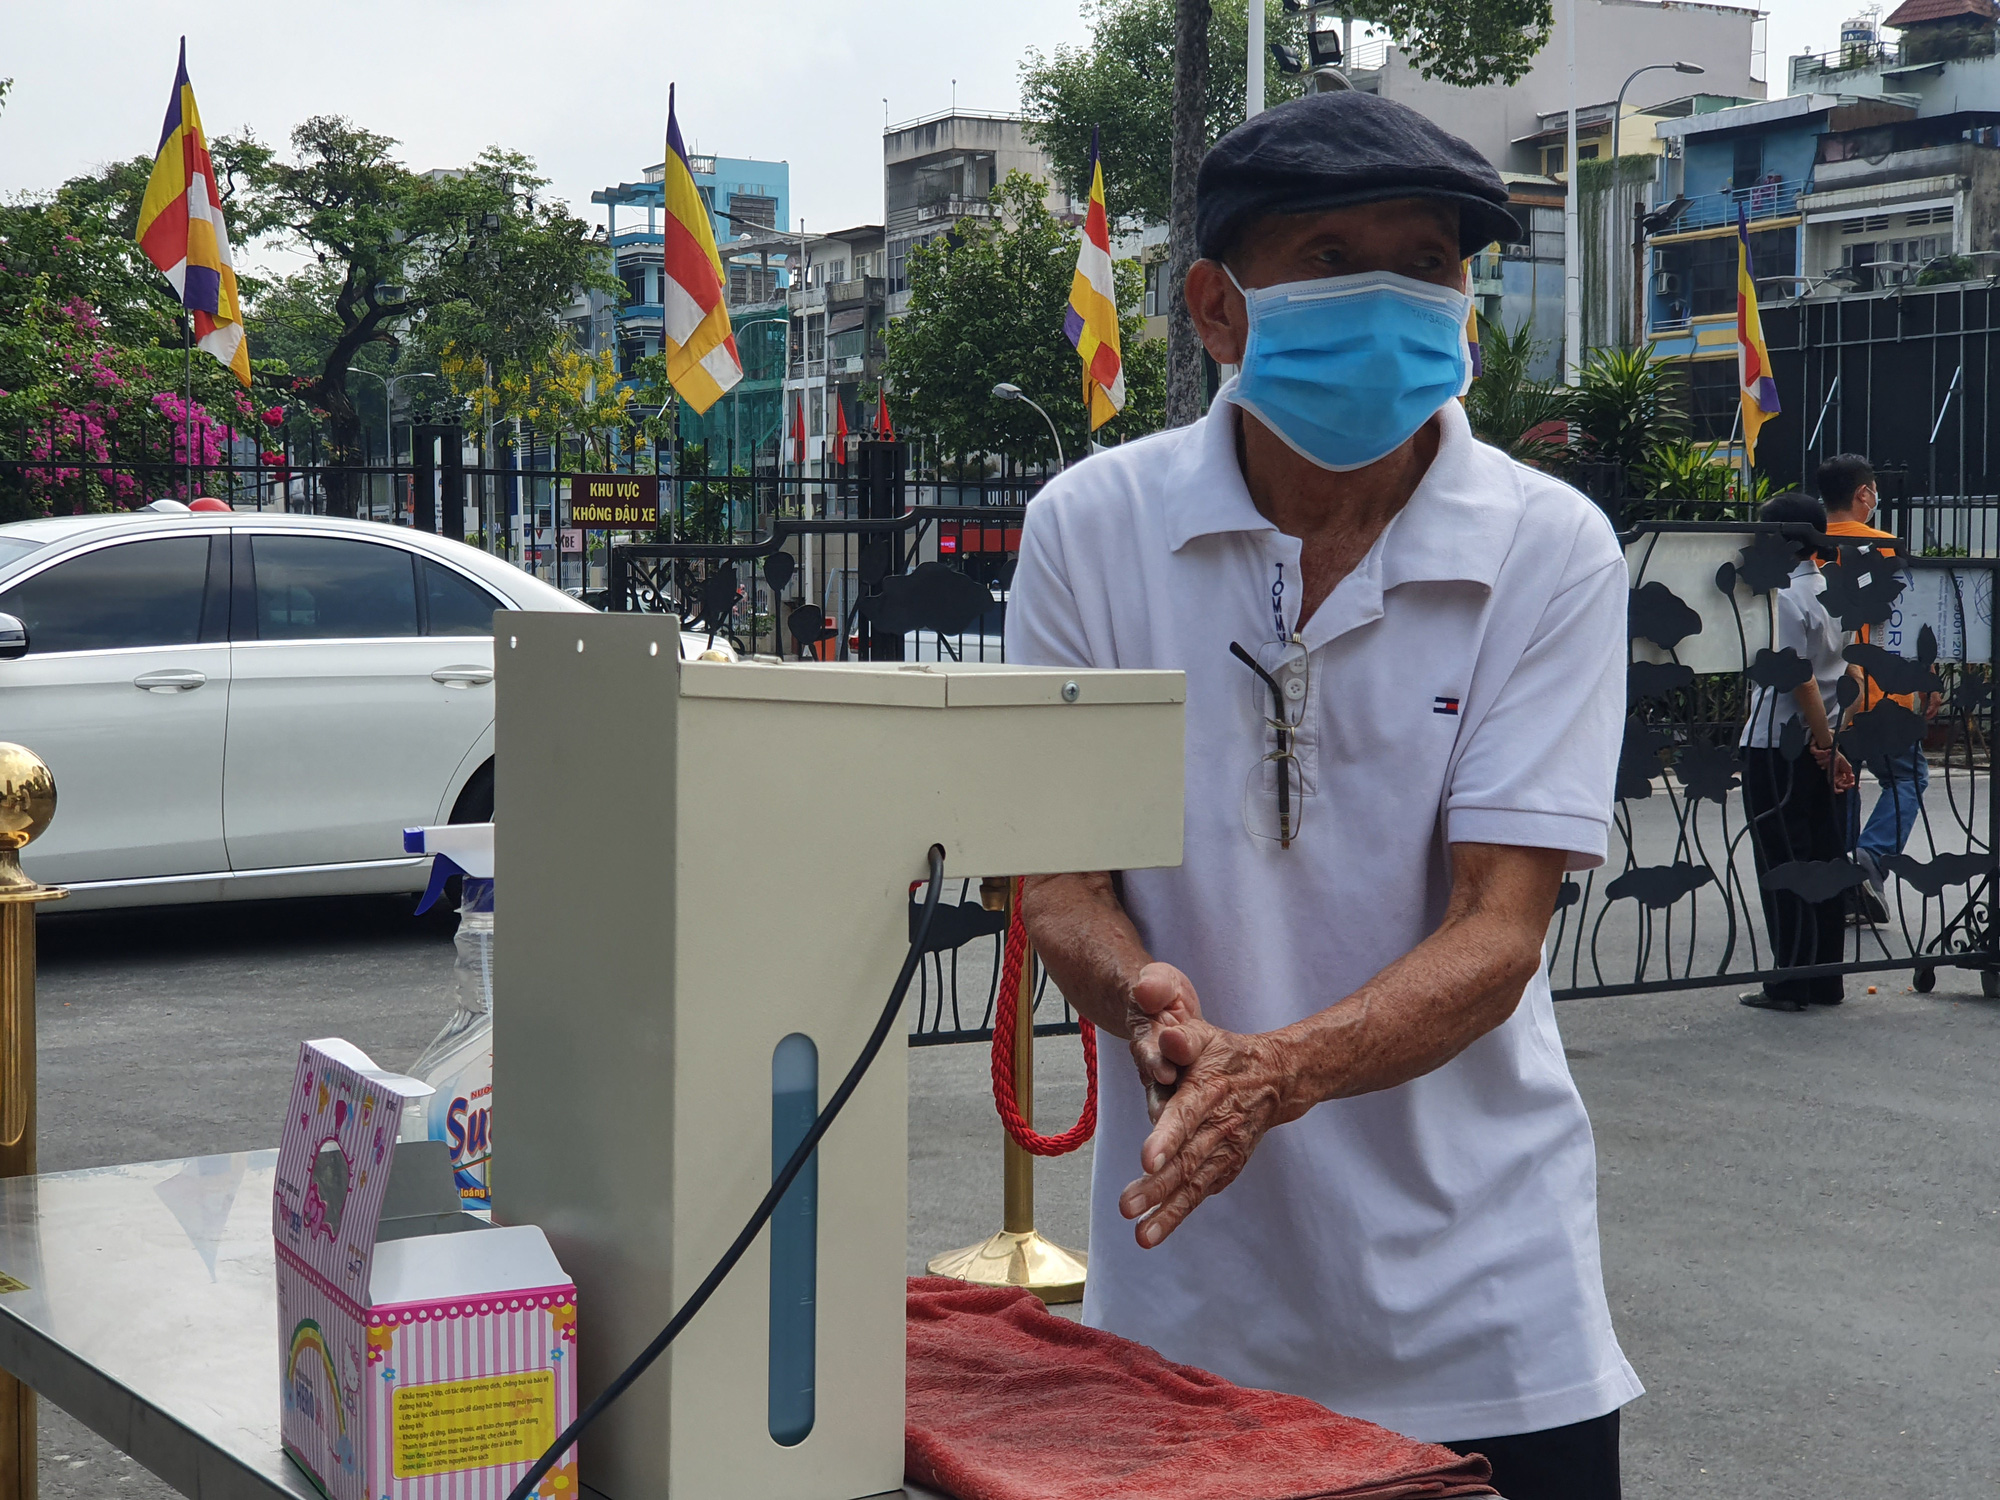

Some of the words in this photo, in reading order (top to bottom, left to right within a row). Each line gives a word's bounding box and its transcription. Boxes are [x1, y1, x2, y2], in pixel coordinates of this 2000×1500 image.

[590, 482, 613, 496] KHU
[617, 481, 640, 500] VỰC
[573, 504, 612, 520] KHÔNG
[615, 504, 638, 524] ĐẬU
[641, 508, 655, 522] XE
[461, 1187, 485, 1198] loáng
